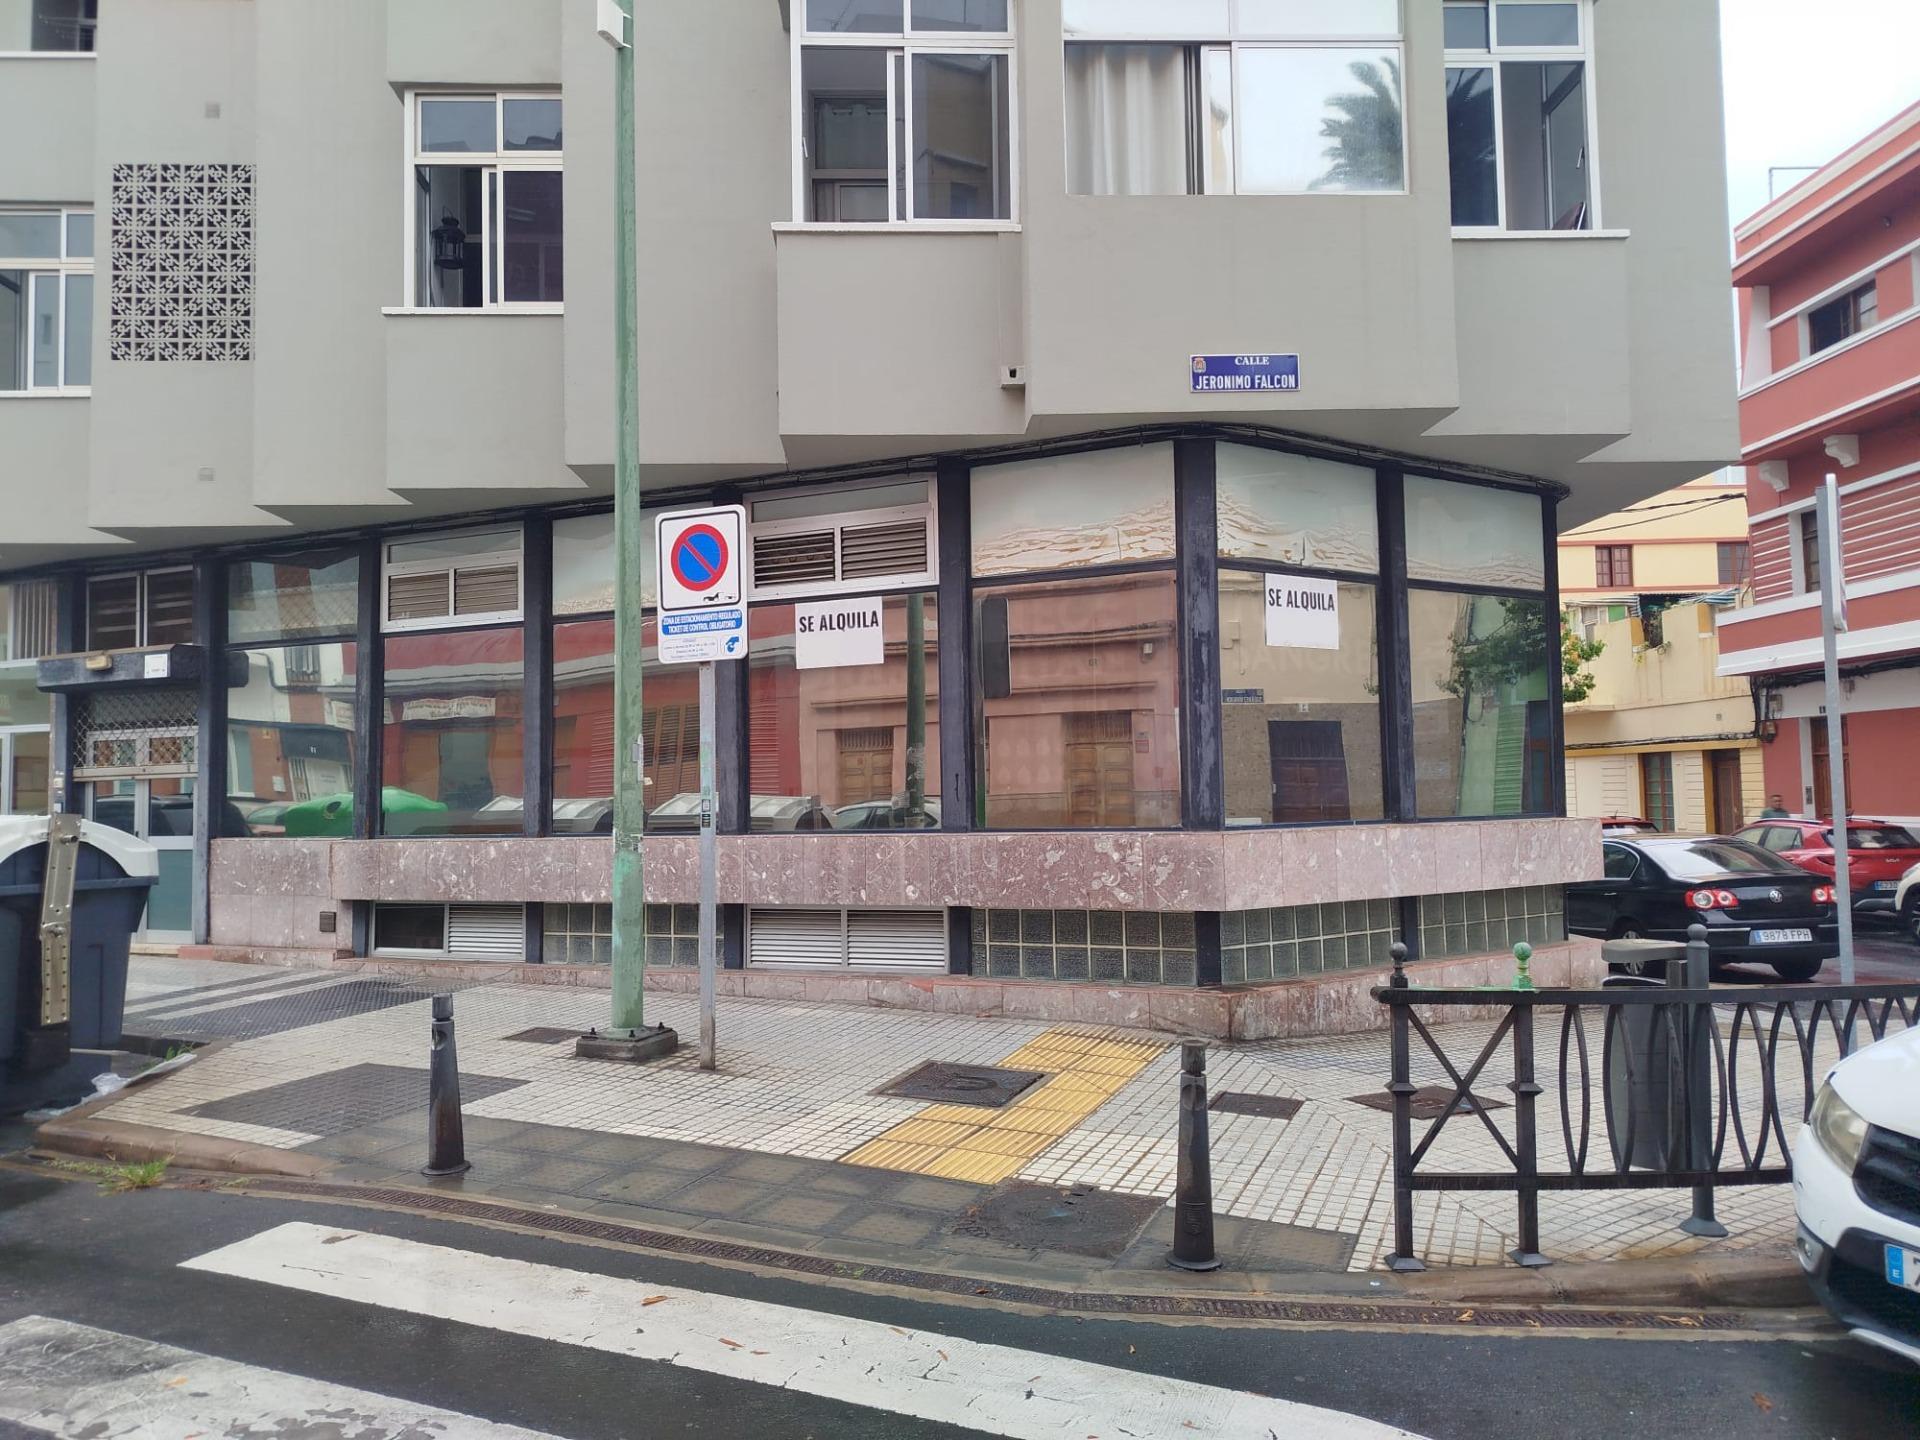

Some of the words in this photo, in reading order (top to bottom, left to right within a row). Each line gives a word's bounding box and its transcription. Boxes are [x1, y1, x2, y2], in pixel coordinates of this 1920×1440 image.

[1234, 356, 1270, 366] CALLE
[1195, 375, 1251, 390] JERONIMO
[1254, 374, 1296, 389] FALCON
[1268, 587, 1282, 608] SE
[1286, 589, 1336, 612] ALQUILA
[799, 615, 815, 633] SE
[819, 610, 880, 633] ALQUILA
[1790, 930, 1810, 940] FPH
[1892, 1269, 1900, 1278] E
